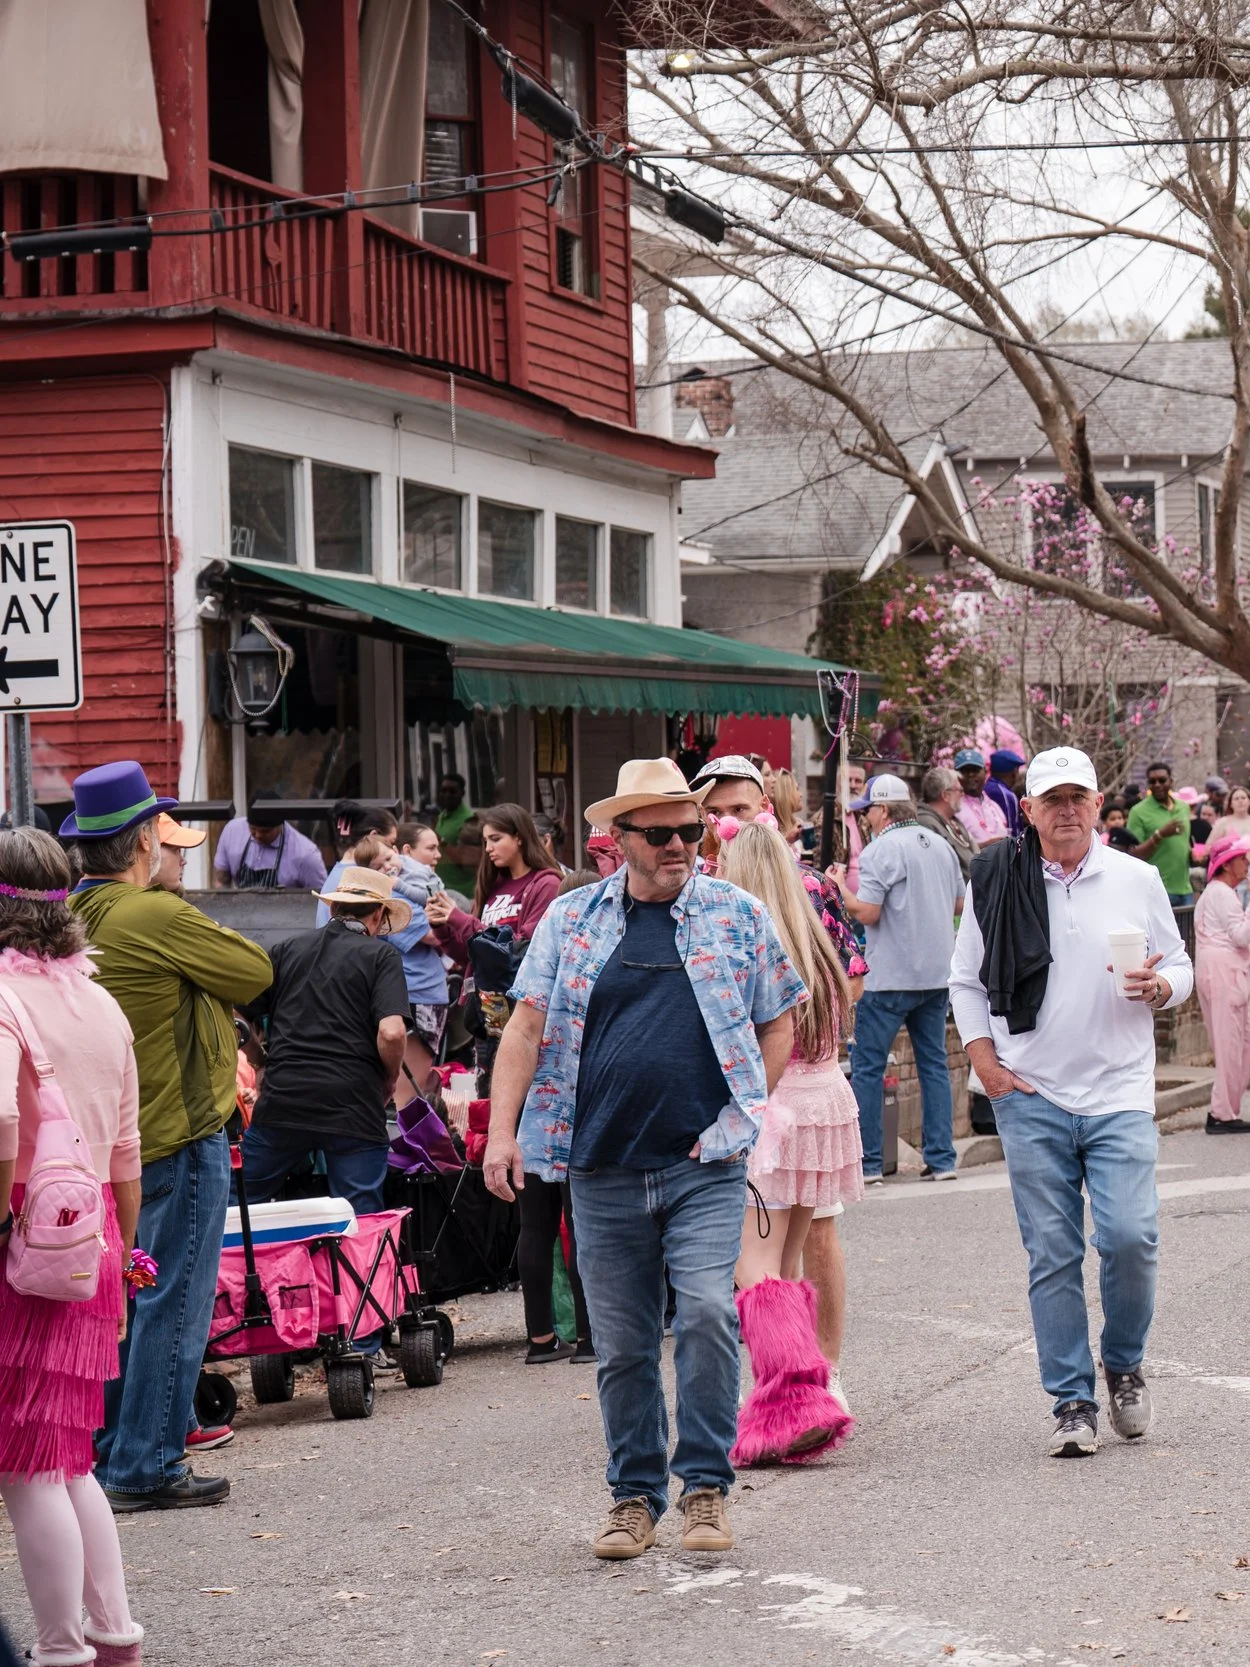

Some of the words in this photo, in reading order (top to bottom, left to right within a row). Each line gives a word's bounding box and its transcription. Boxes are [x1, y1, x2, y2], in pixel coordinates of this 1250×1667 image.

[0, 541, 57, 583] NE
[231, 525, 256, 557] PEN
[0, 592, 60, 635] AY
